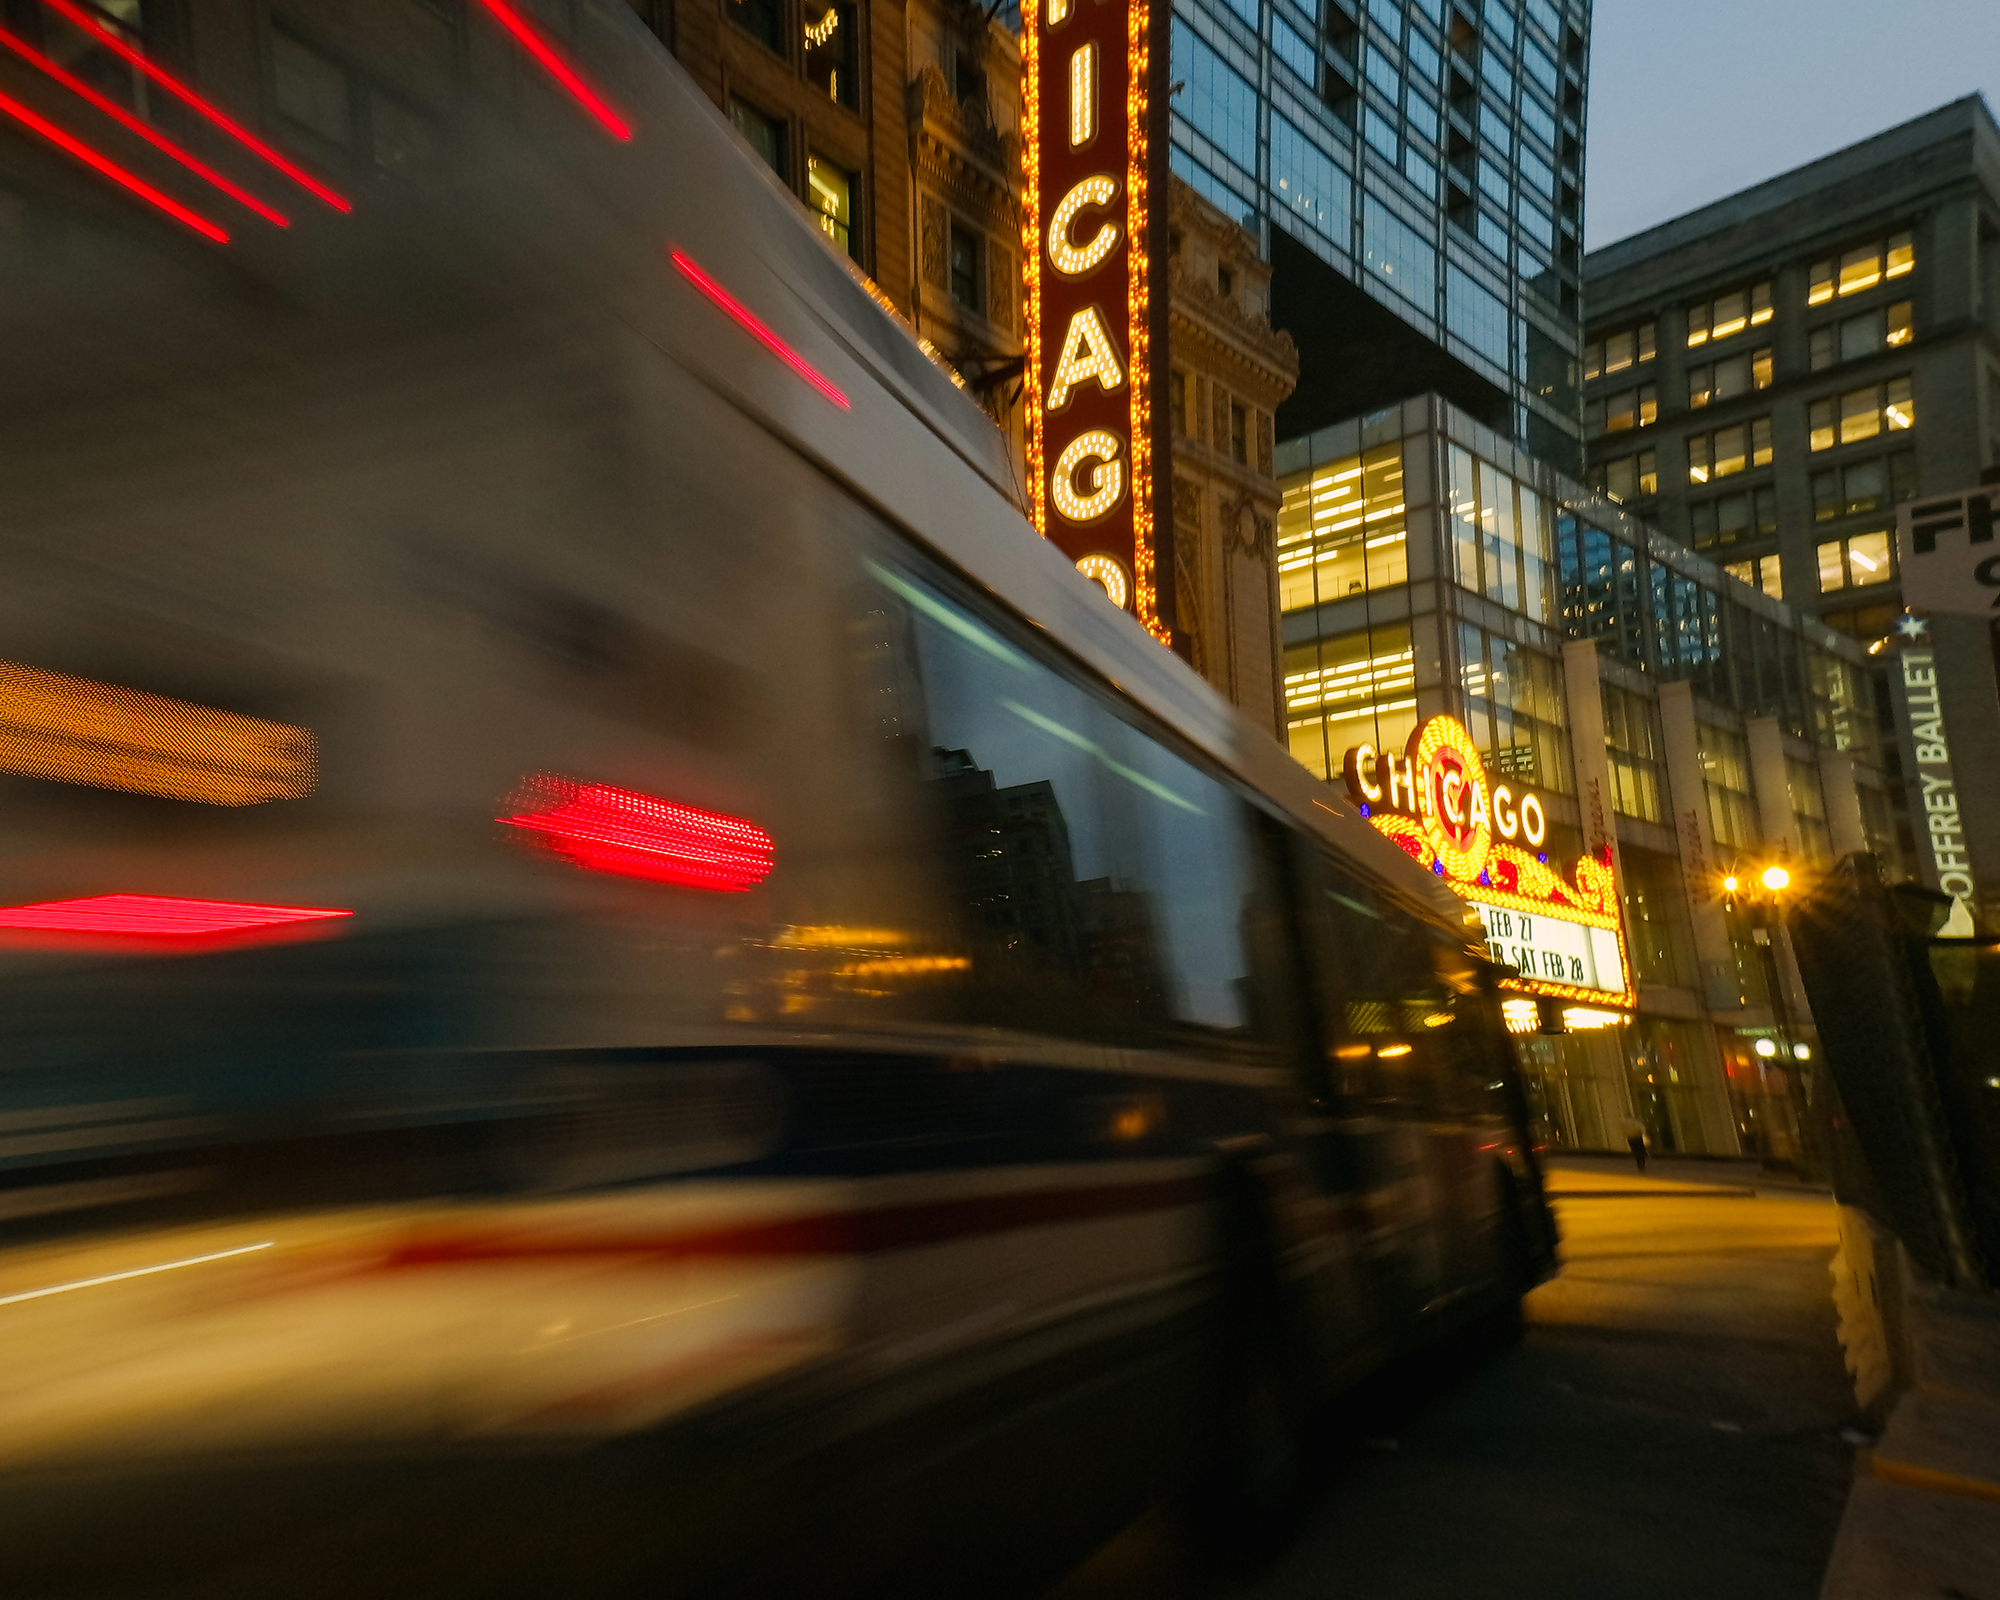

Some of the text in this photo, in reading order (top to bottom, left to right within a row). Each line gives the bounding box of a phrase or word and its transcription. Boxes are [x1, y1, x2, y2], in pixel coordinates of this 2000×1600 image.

[1047, 0, 1127, 611] ICAG
[1356, 742, 1545, 847] CHICAGO
[1904, 654, 1975, 905] OFFREY BALLET
[1489, 910, 1532, 942] FEB 27
[1511, 945, 1537, 975] SAT
[1542, 951, 1565, 978] FEB
[1568, 956, 1584, 982] 28
